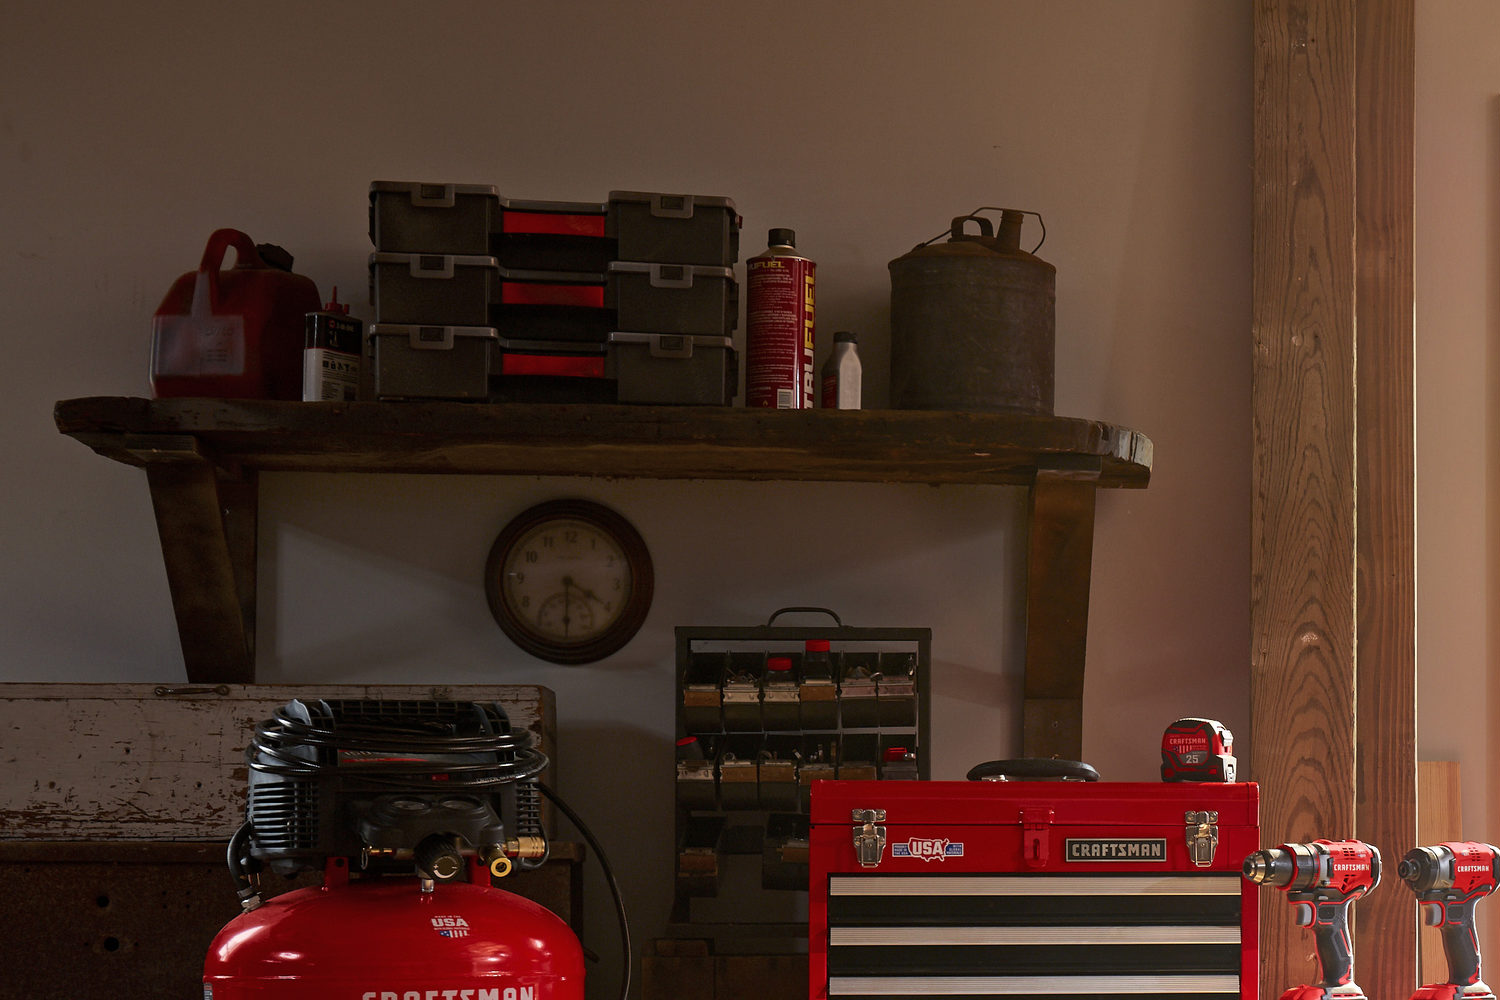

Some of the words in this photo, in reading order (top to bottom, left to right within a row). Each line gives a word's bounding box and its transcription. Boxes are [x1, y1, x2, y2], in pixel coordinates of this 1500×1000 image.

[804, 267, 816, 409] TRUFUEL
[543, 536, 554, 548] 11
[565, 531, 577, 544] 12
[591, 539, 597, 550] 1
[526, 552, 538, 564] 10
[517, 573, 524, 585] 9
[614, 579, 621, 591] 3
[522, 596, 530, 608] 8
[1169, 737, 1207, 745] CRAFTSMAN
[1186, 754, 1199, 764] 25
[912, 841, 944, 855] USA
[1072, 843, 1161, 857] CRAFTSMAN
[1333, 863, 1370, 872] CRAFTSMAN
[431, 918, 469, 927] USA
